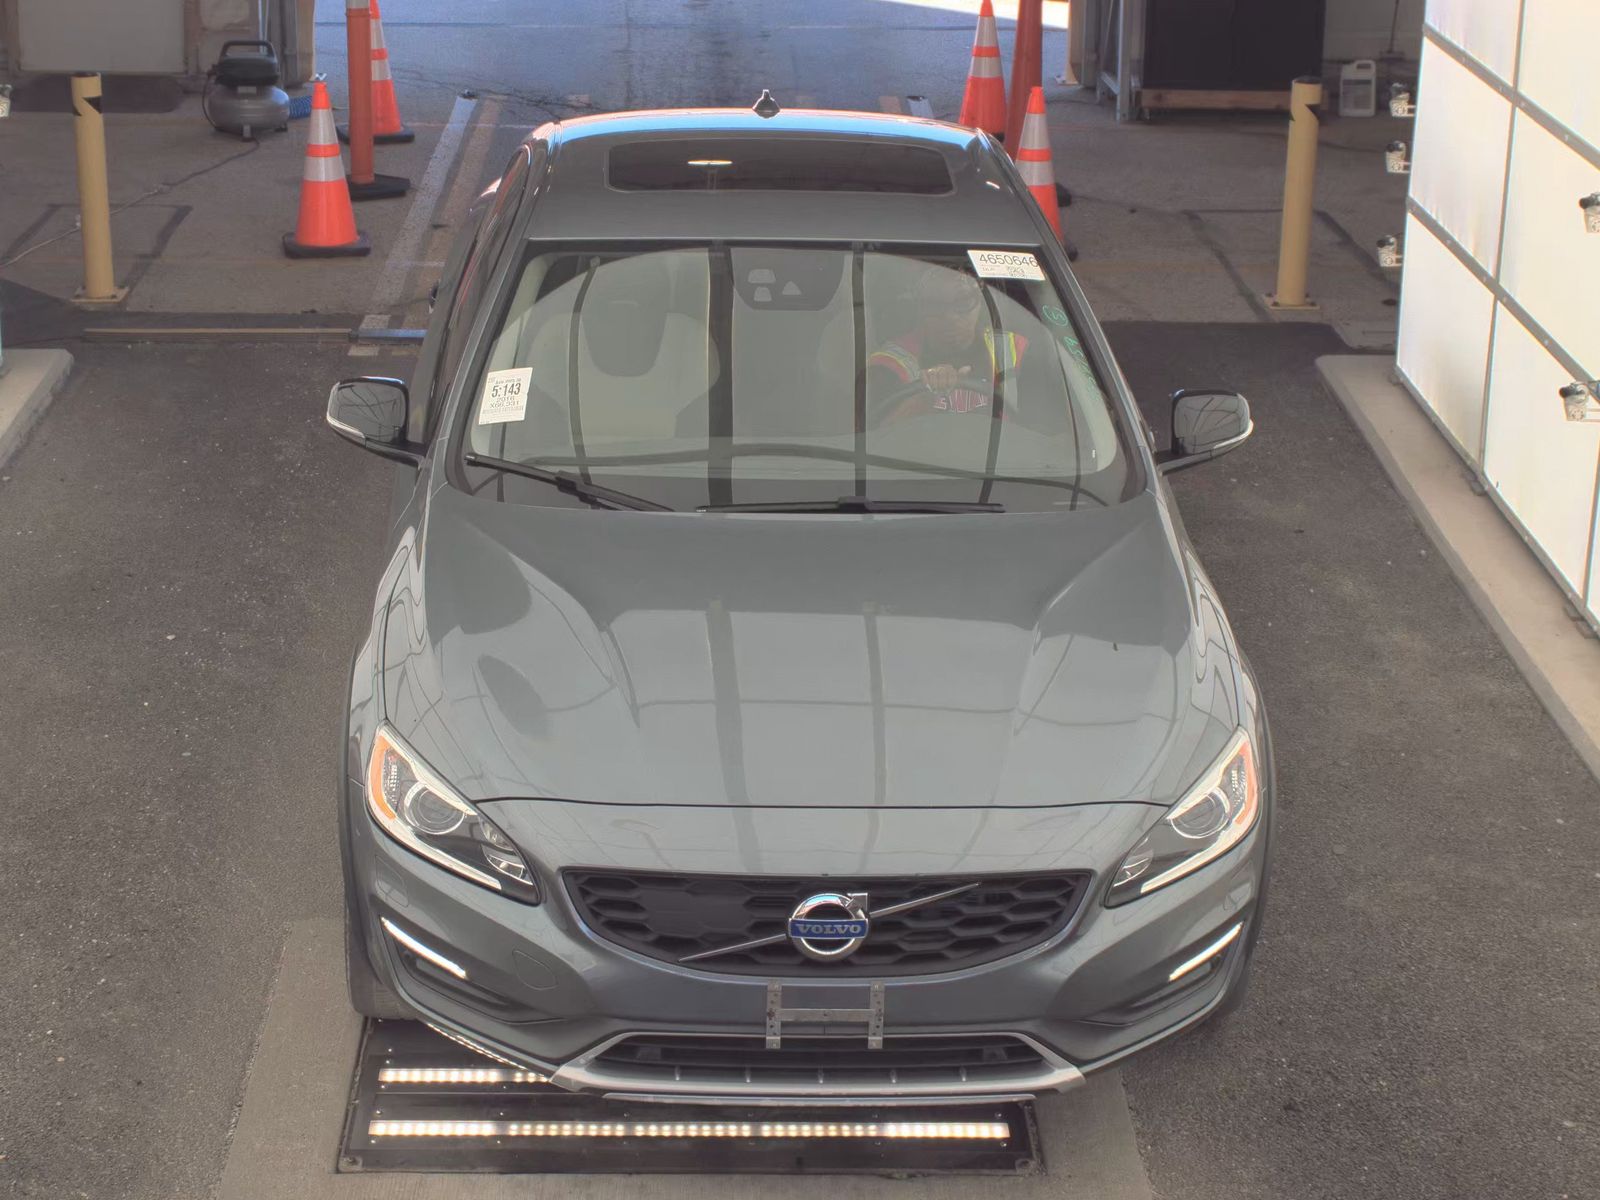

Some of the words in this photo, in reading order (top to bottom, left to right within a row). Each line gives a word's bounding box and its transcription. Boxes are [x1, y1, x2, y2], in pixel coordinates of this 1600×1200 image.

[980, 254, 1039, 268] 4650646
[491, 382, 521, 398] 5:143
[795, 923, 862, 935] VOLVO
